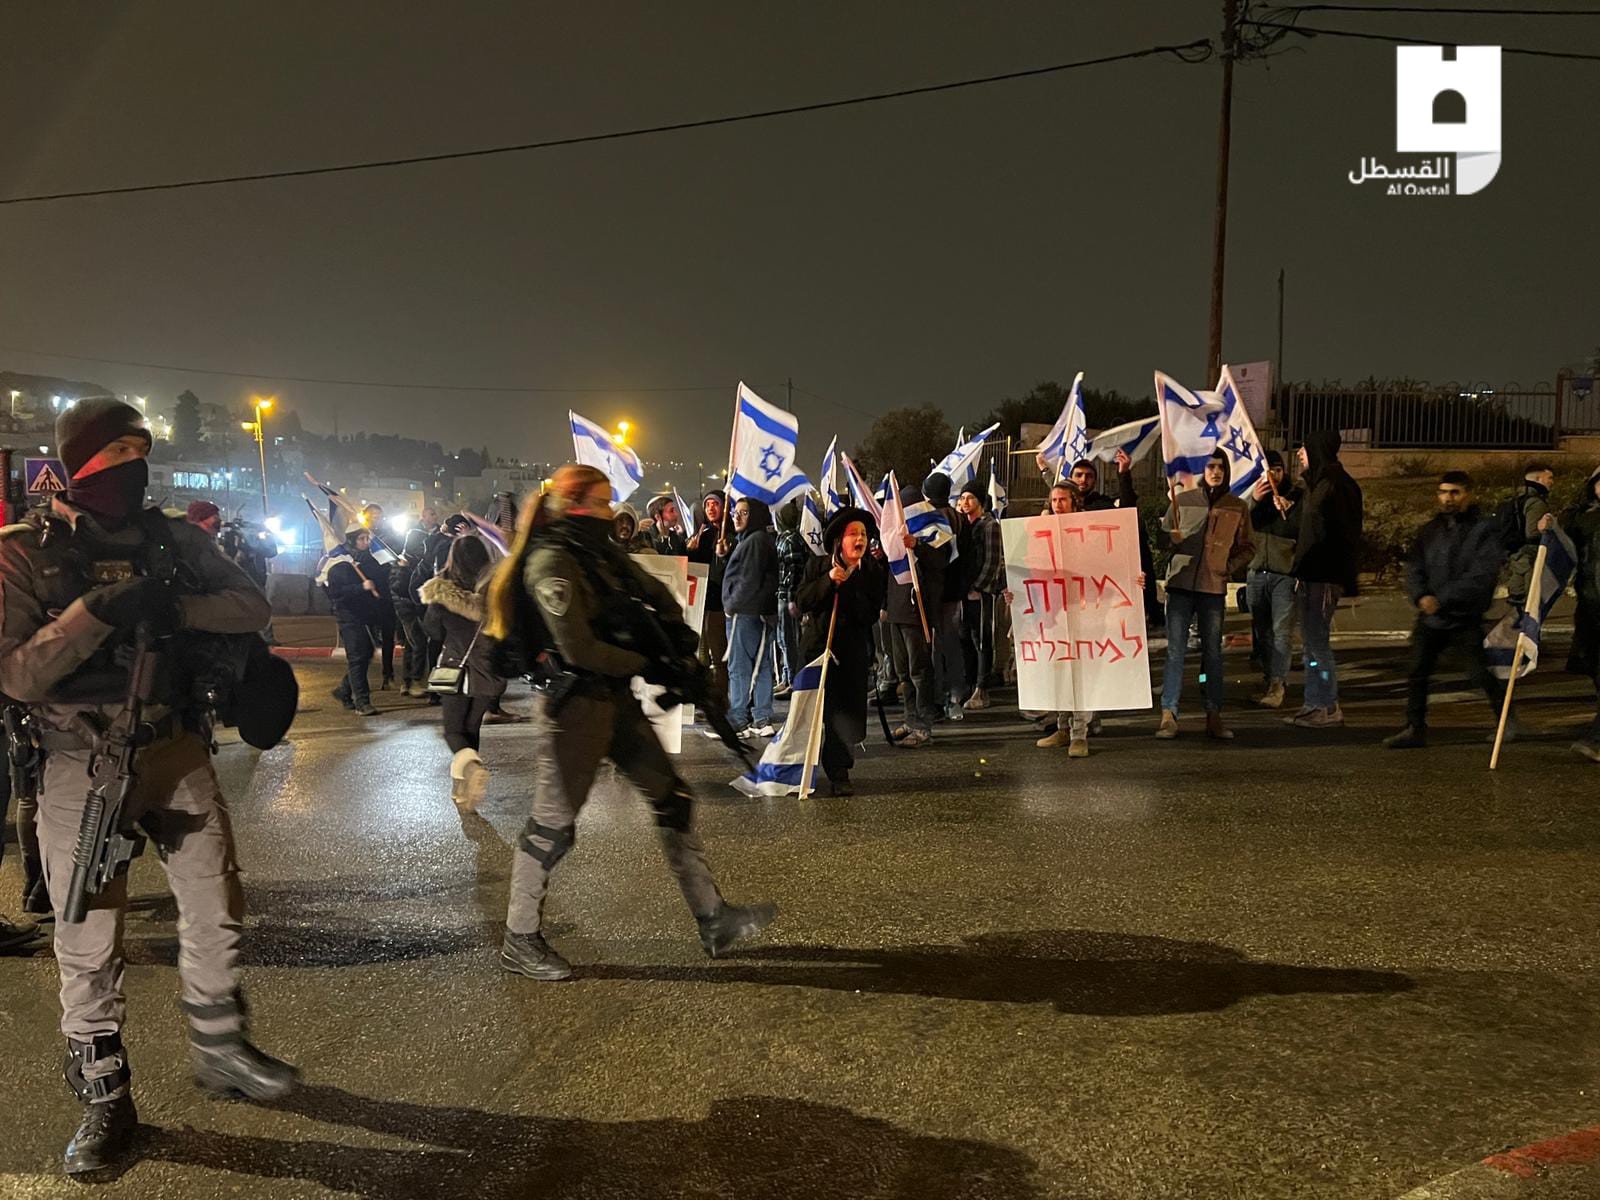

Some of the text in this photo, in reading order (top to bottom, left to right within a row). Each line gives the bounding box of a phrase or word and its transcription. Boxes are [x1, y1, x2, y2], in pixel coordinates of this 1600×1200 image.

[1033, 524, 1121, 573] דרך
[1023, 574, 1133, 615] מוות
[1020, 618, 1143, 664] למחבלים
